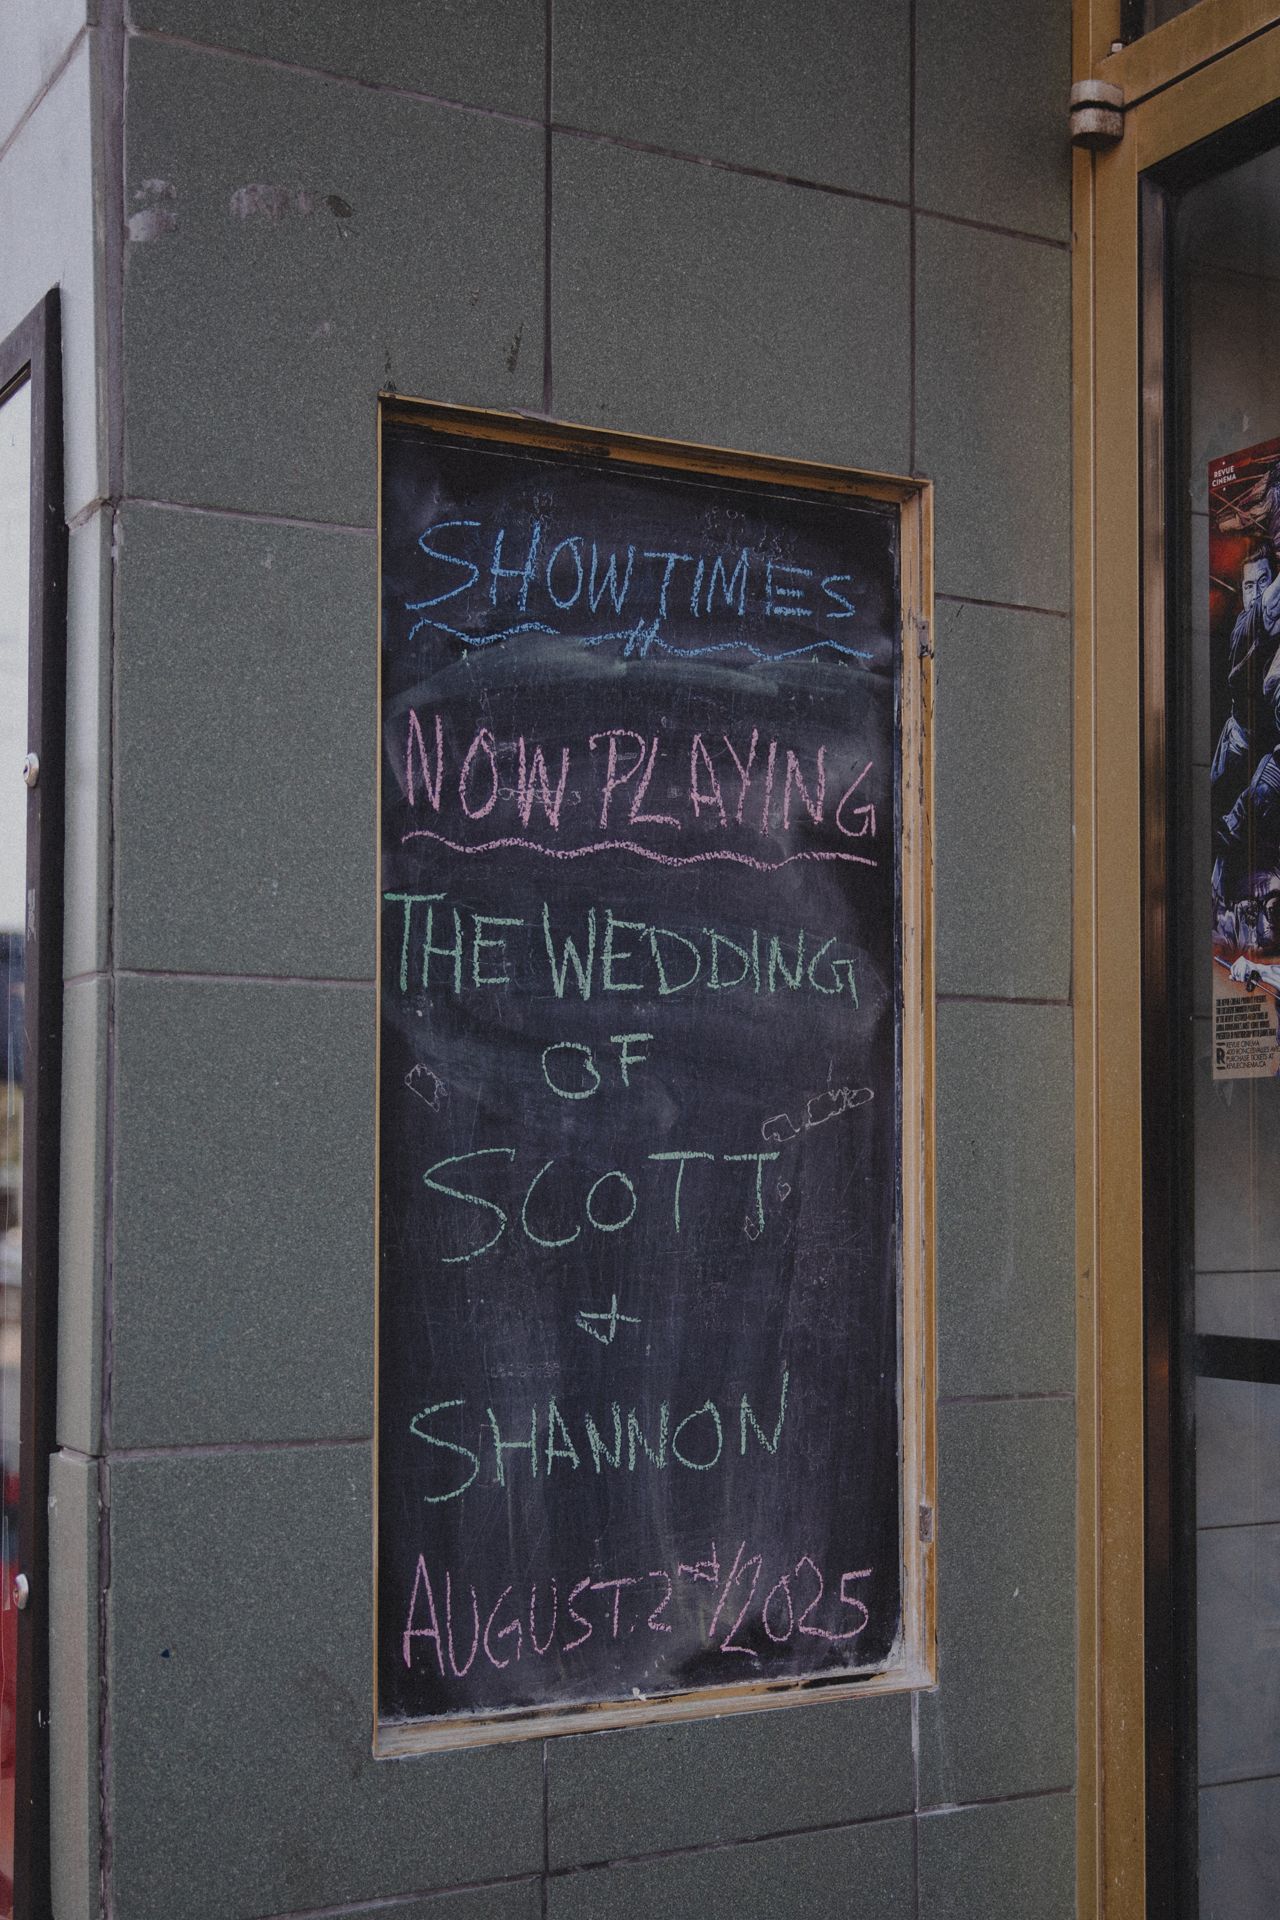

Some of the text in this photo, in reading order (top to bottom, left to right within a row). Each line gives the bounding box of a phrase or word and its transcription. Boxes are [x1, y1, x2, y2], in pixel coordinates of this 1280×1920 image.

[1212, 473, 1237, 487] CINEMA
[1214, 465, 1235, 478] REVUE
[405, 520, 856, 618] SHOWTIMES
[405, 707, 877, 838] NOW PLAYING
[384, 891, 860, 1009] THE WEDDING
[541, 1033, 654, 1100] OF
[422, 1147, 781, 1263] SCOTT
[409, 1369, 790, 1502] SHANNON
